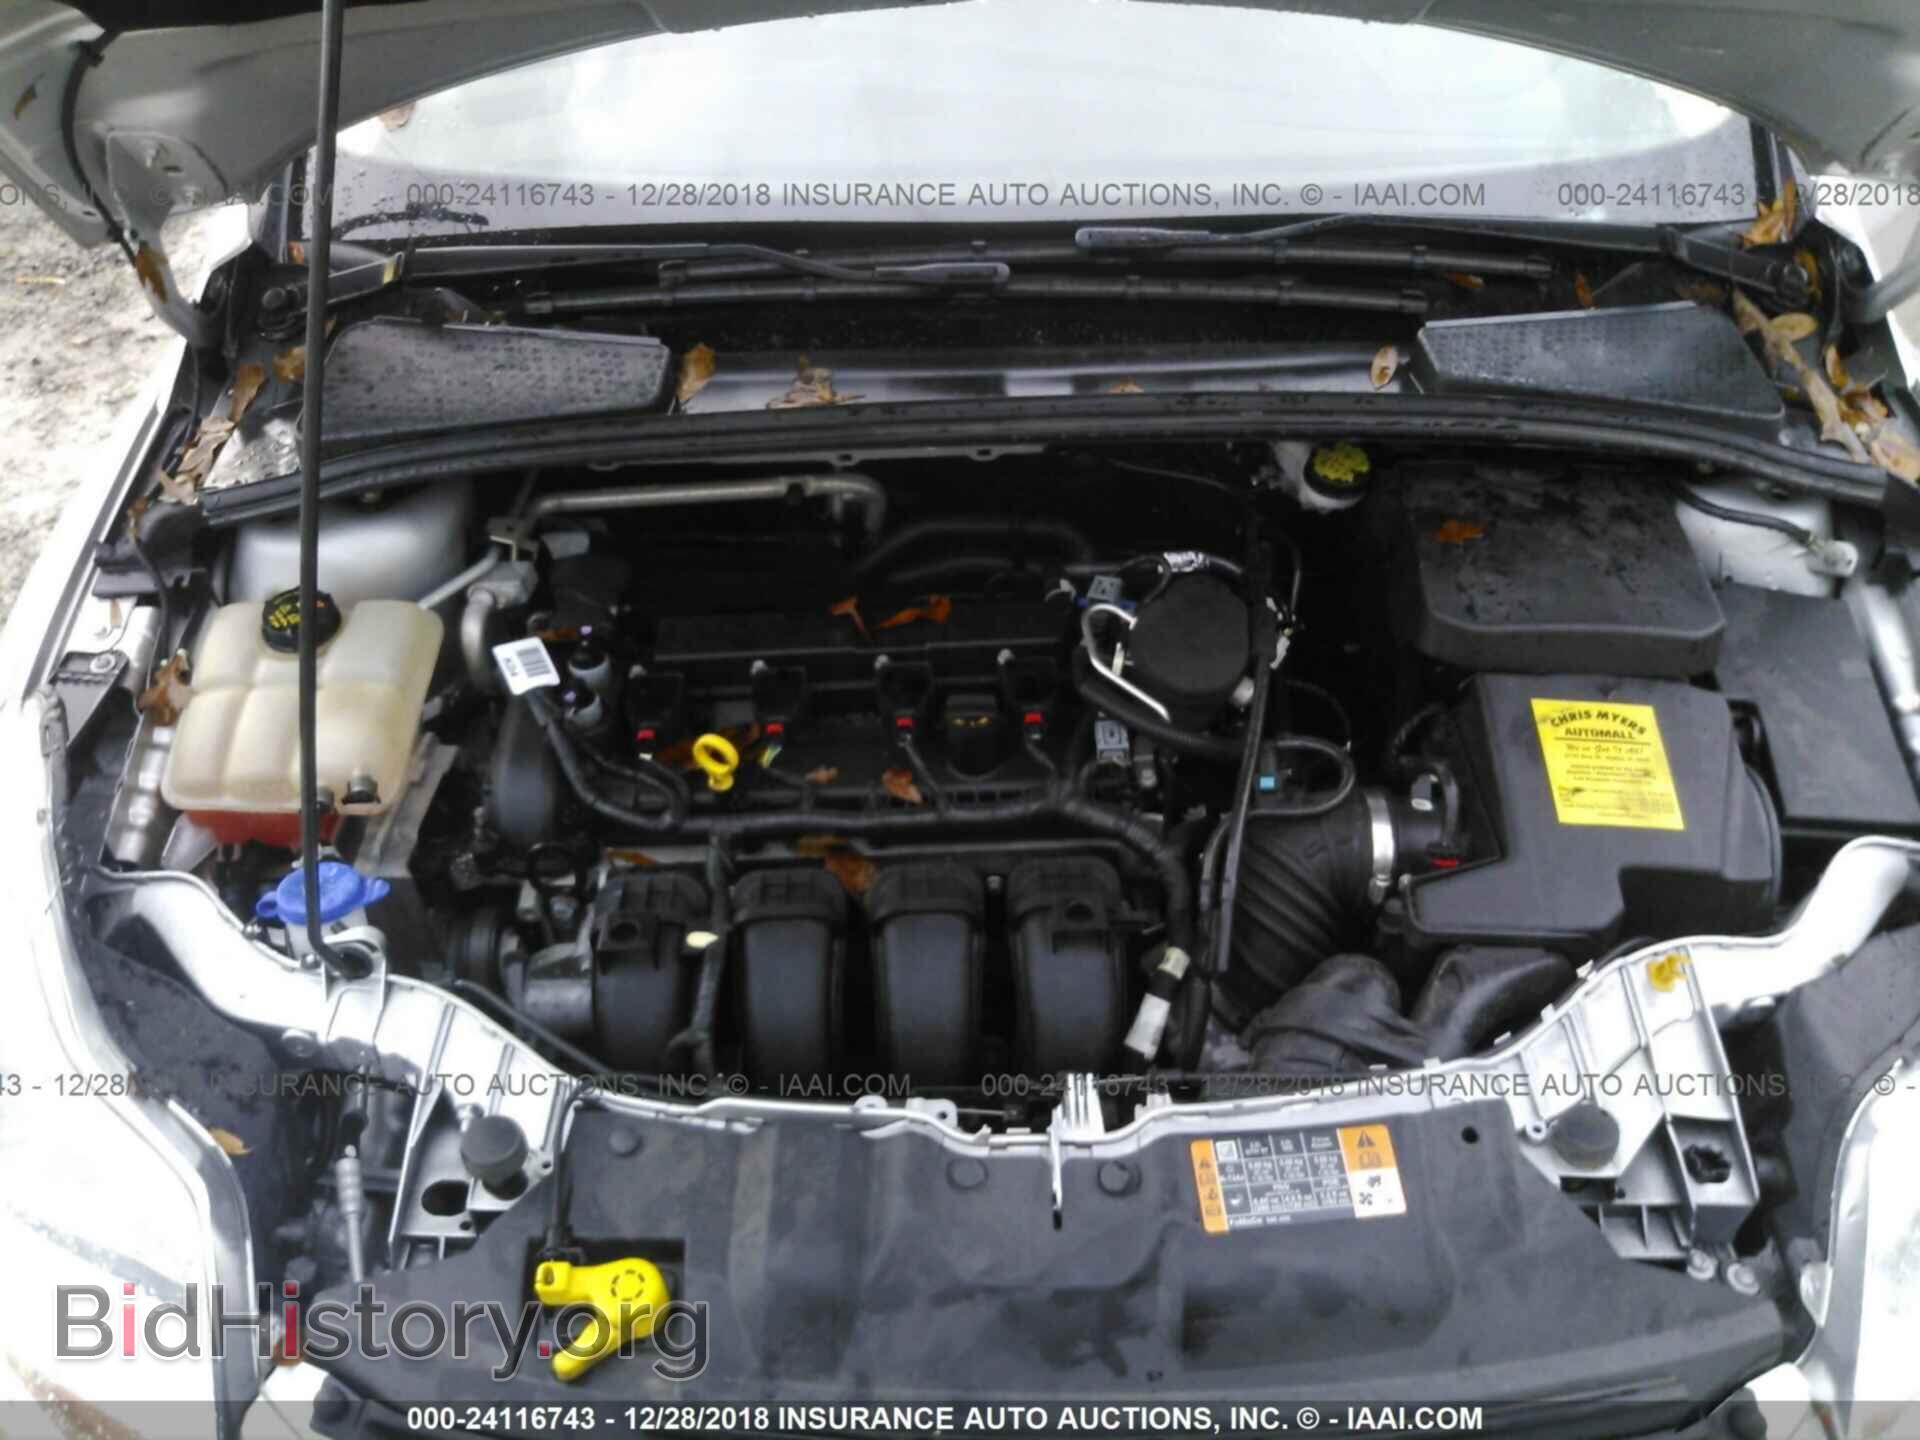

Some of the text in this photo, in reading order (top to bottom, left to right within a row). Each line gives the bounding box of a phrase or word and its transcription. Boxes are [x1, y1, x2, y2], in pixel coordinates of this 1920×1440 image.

[1551, 709, 1646, 735] CHRIS MYERS
[1565, 727, 1636, 739] AUTOMALL
